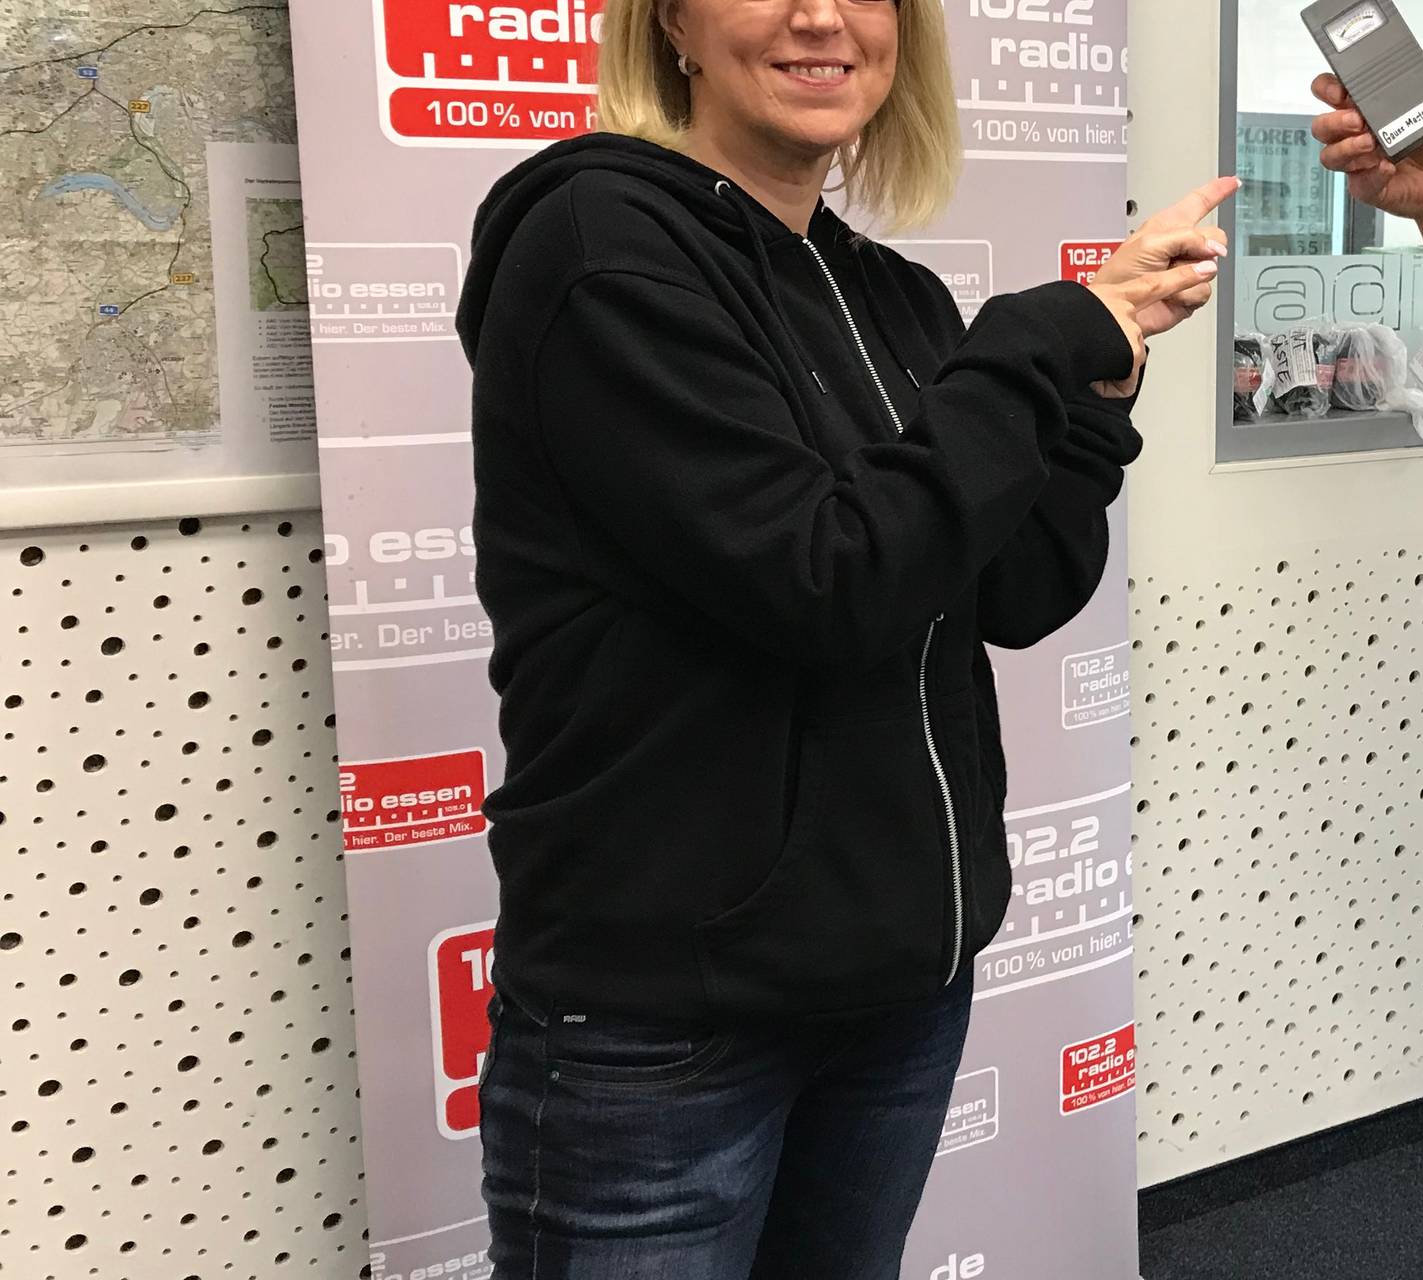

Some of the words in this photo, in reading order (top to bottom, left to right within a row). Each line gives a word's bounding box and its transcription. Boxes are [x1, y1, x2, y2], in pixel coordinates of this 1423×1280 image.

[991, 32, 1113, 72] radio
[529, 110, 575, 128] von
[1047, 127, 1079, 143] von
[1086, 125, 1117, 145] hier.
[1067, 247, 1112, 266] 102.2
[350, 282, 445, 298] essen
[319, 323, 348, 335] hier.
[353, 322, 378, 335] Der
[382, 321, 417, 334] beste
[421, 321, 447, 333] Mix.
[378, 624, 433, 648] Der
[1070, 654, 1115, 679] 102.2
[1079, 672, 1121, 694] radio
[380, 785, 472, 808] essen
[352, 836, 379, 846] hier.
[385, 832, 407, 843] Der
[412, 827, 445, 839] beste
[450, 821, 473, 833] Mix.
[1051, 943, 1083, 964] von
[1090, 930, 1122, 954] hier.
[1068, 1037, 1117, 1067] 102.2
[1078, 1055, 1124, 1081] radio
